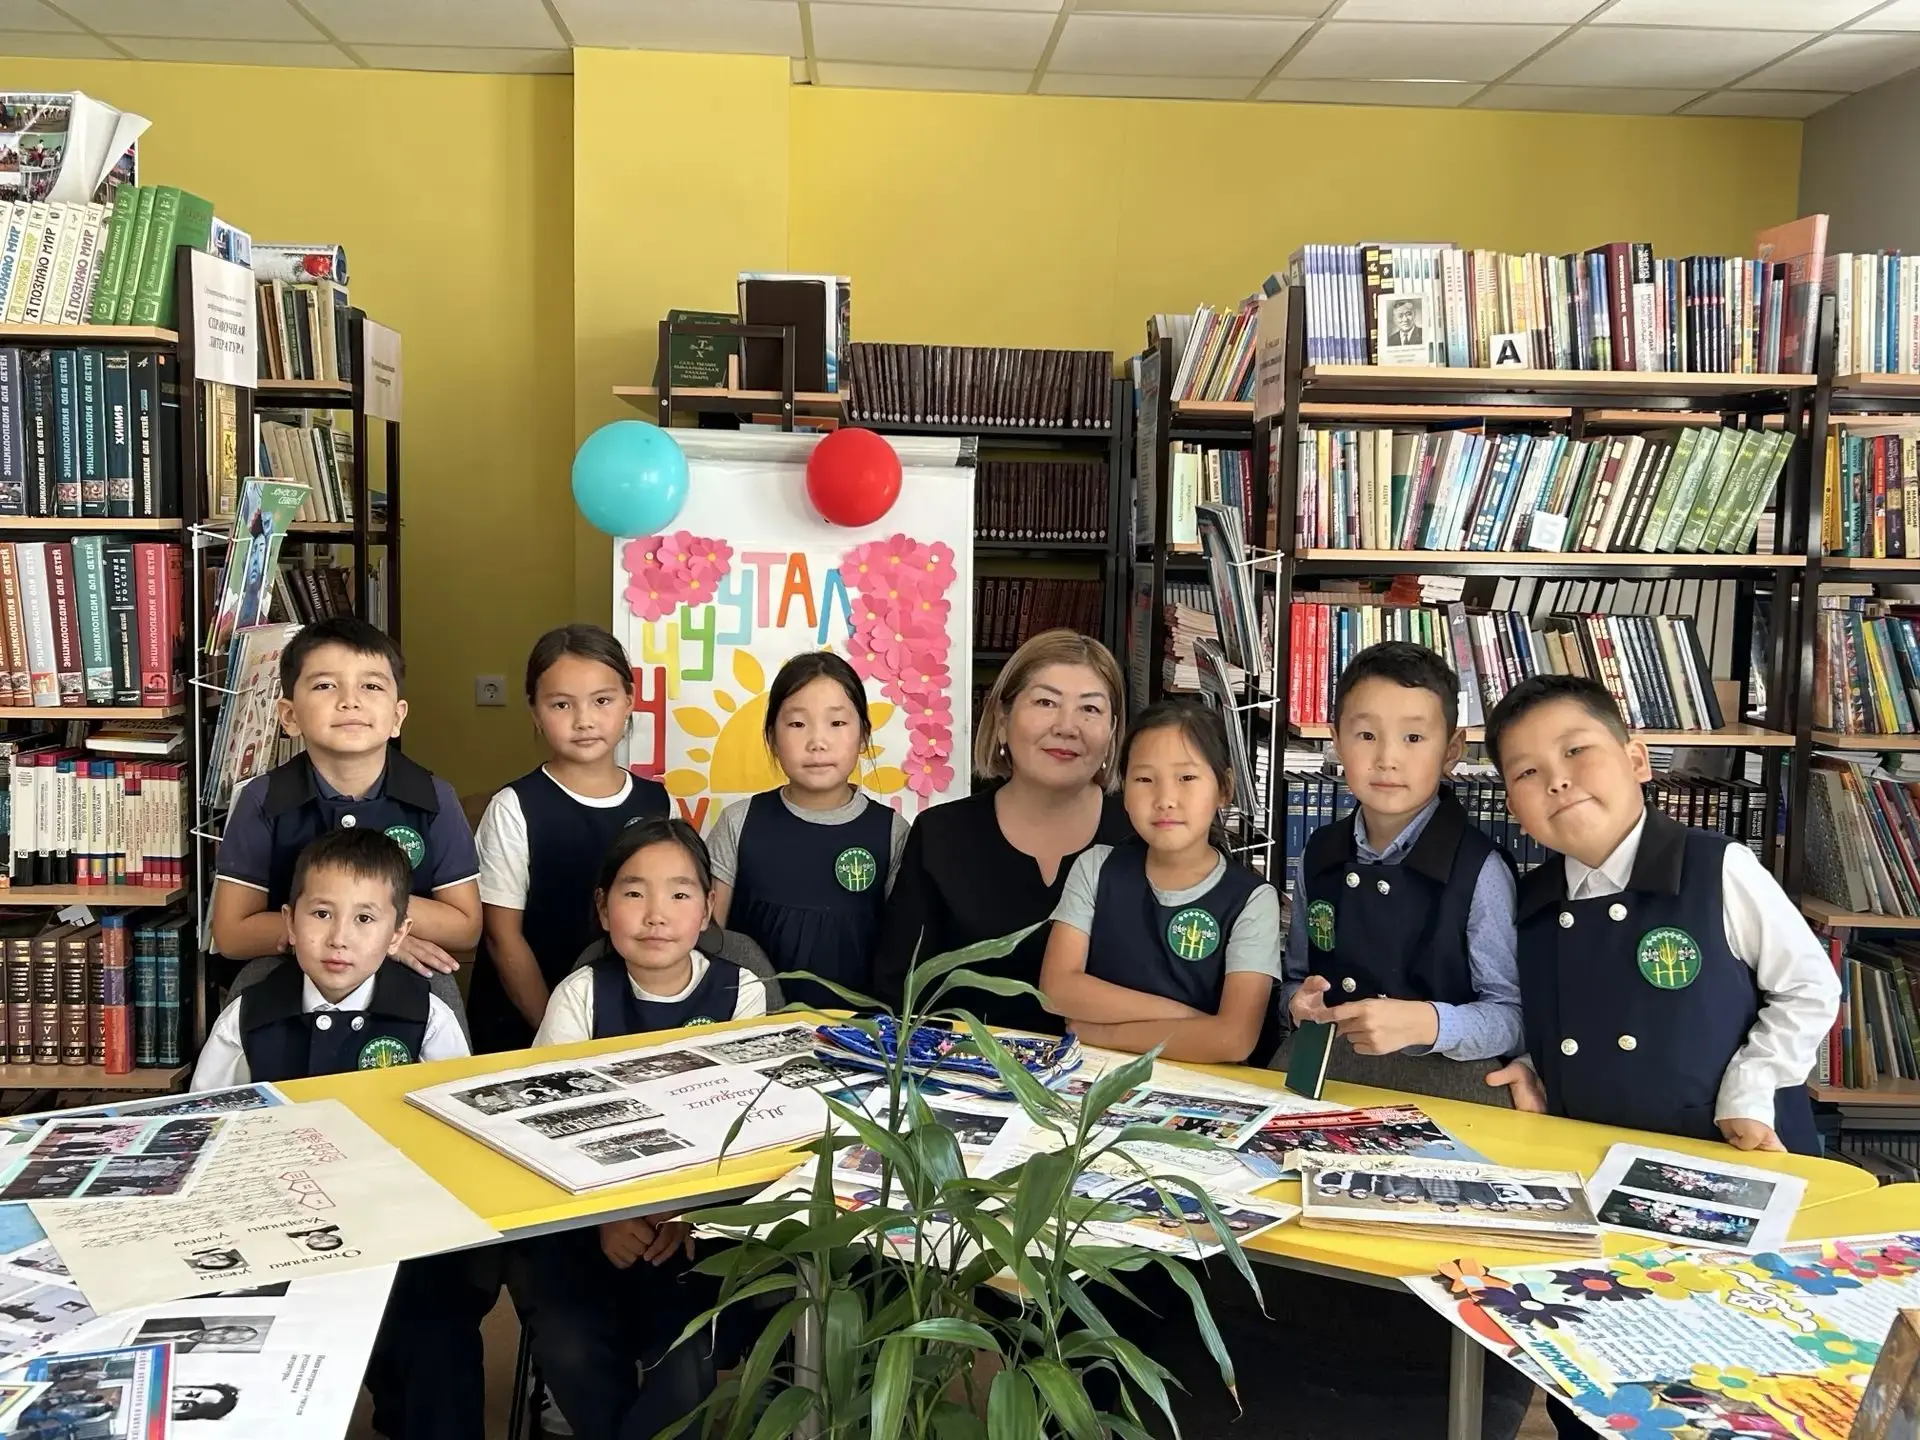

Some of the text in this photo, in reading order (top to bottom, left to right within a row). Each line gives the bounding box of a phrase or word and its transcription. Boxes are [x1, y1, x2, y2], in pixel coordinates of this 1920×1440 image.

[6, 226, 21, 253] МИР
[26, 227, 56, 318] Я ПОЗНАЮ МИР
[65, 229, 95, 321] Я ПОЗНАЮ МИР
[208, 317, 246, 337] СПРАВОЧНАЯ
[208, 336, 245, 355] ЛИТЕРАТУРА
[1496, 339, 1521, 365] А
[59, 358, 68, 384] ДЕТЕЙ
[0, 385, 8, 402] ДЛЯ
[61, 388, 69, 404] ДЛЯ
[83, 355, 94, 475] ЭНЦИКЛОПЕДИЯ ДЛЯ ДЕТЕЙ
[114, 406, 124, 445] ХИМИЯ
[1, 406, 12, 475] ЭНЦИКЛОПЕДИЯ
[146, 549, 154, 575] ДЕТЕЙ
[113, 558, 121, 601] ИСТОРИЯ
[1, 549, 21, 667] ЭНЦИКЛОПЕДИЯ ДЛЯ ДЕТЕЙ
[52, 549, 71, 667] ЭНЦИКЛОПЕДИЯ ДЛЯ ДЕТЕЙ
[85, 544, 102, 661] ЭНЦИКЛОПЕДИЯ ДЛЯ ДЕТЕЙ
[149, 599, 158, 667] ЭНЦИКЛОПЕДИЯ
[665, 1077, 729, 1097] классах
[269, 1249, 362, 1271] Отличники
